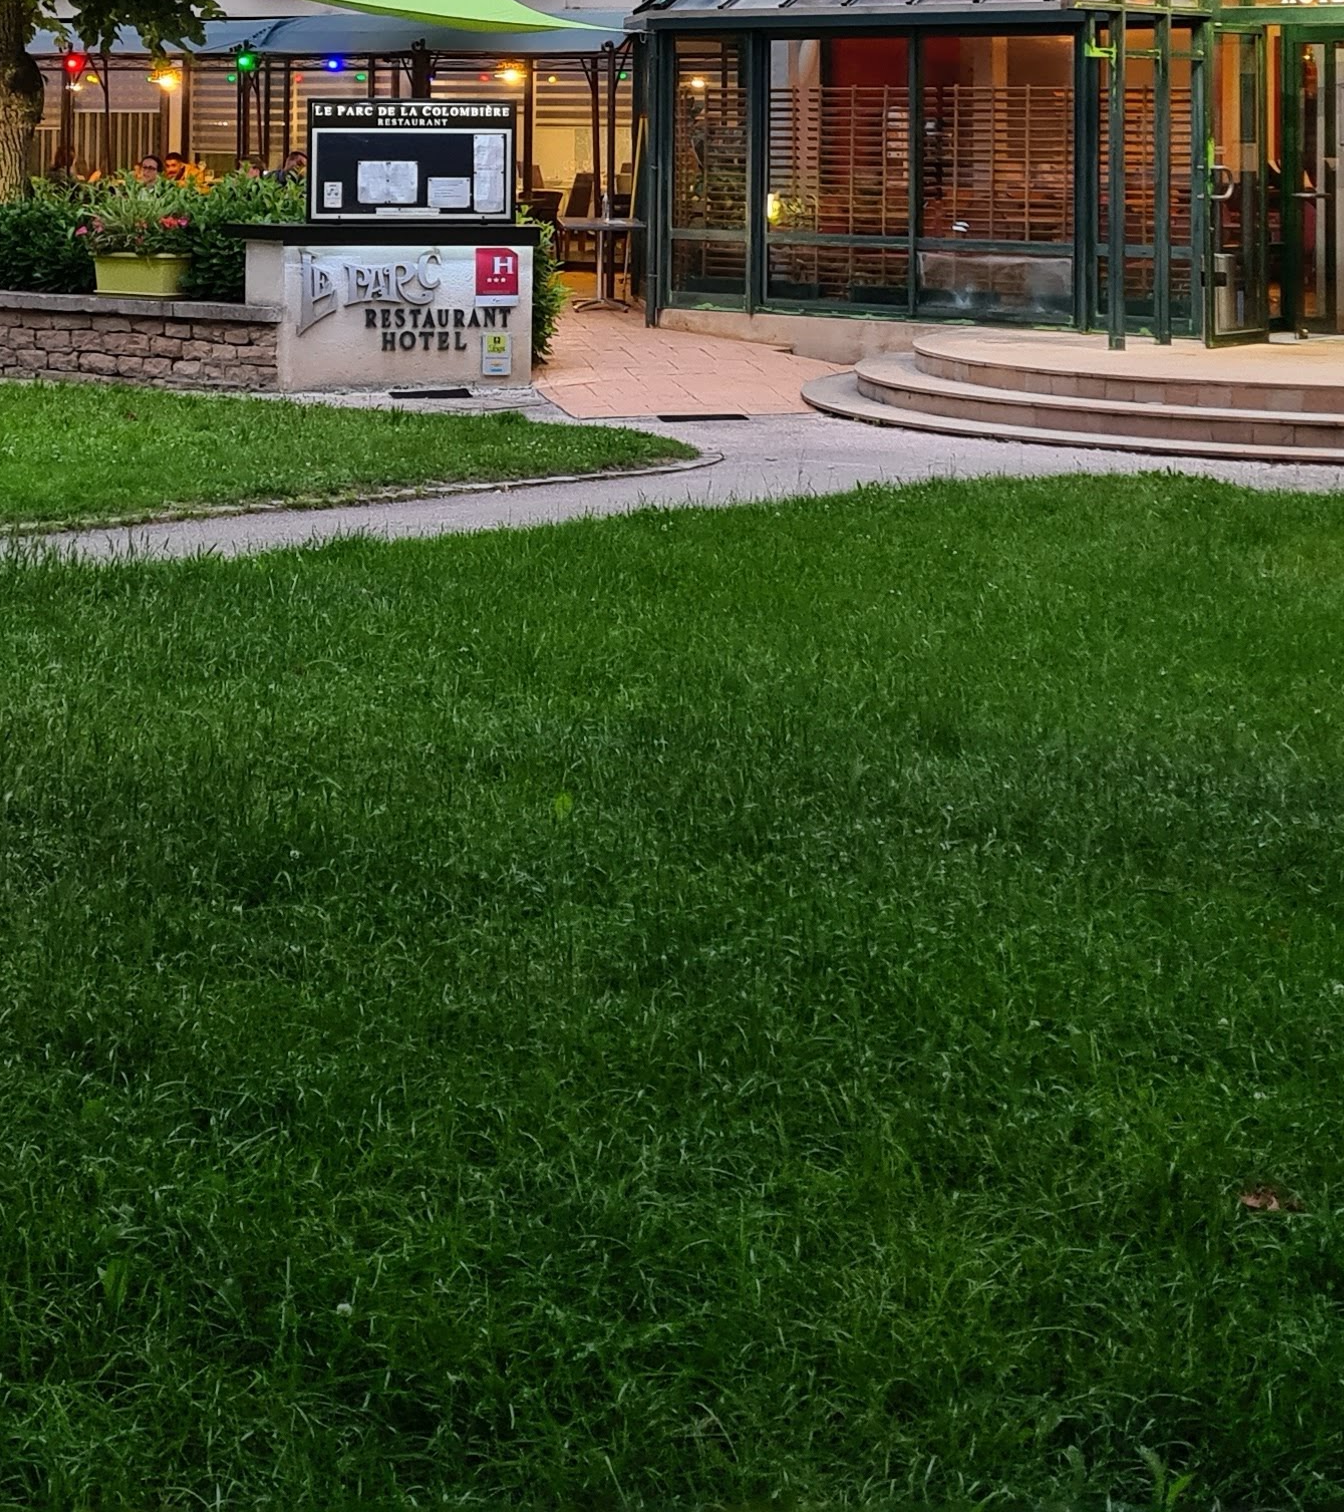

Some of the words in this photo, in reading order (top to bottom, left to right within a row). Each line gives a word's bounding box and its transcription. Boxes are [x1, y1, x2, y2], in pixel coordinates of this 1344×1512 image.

[315, 105, 332, 116] LE
[337, 105, 374, 116] PARC
[378, 106, 395, 116] DE
[400, 106, 418, 116] LA
[422, 105, 510, 117] COLOMBIÈRE
[377, 118, 448, 126] RESTAURANT
[493, 256, 514, 274] H
[343, 248, 443, 306] PARC
[365, 308, 512, 329] RESTAURANT
[381, 331, 468, 351] HOTEL
